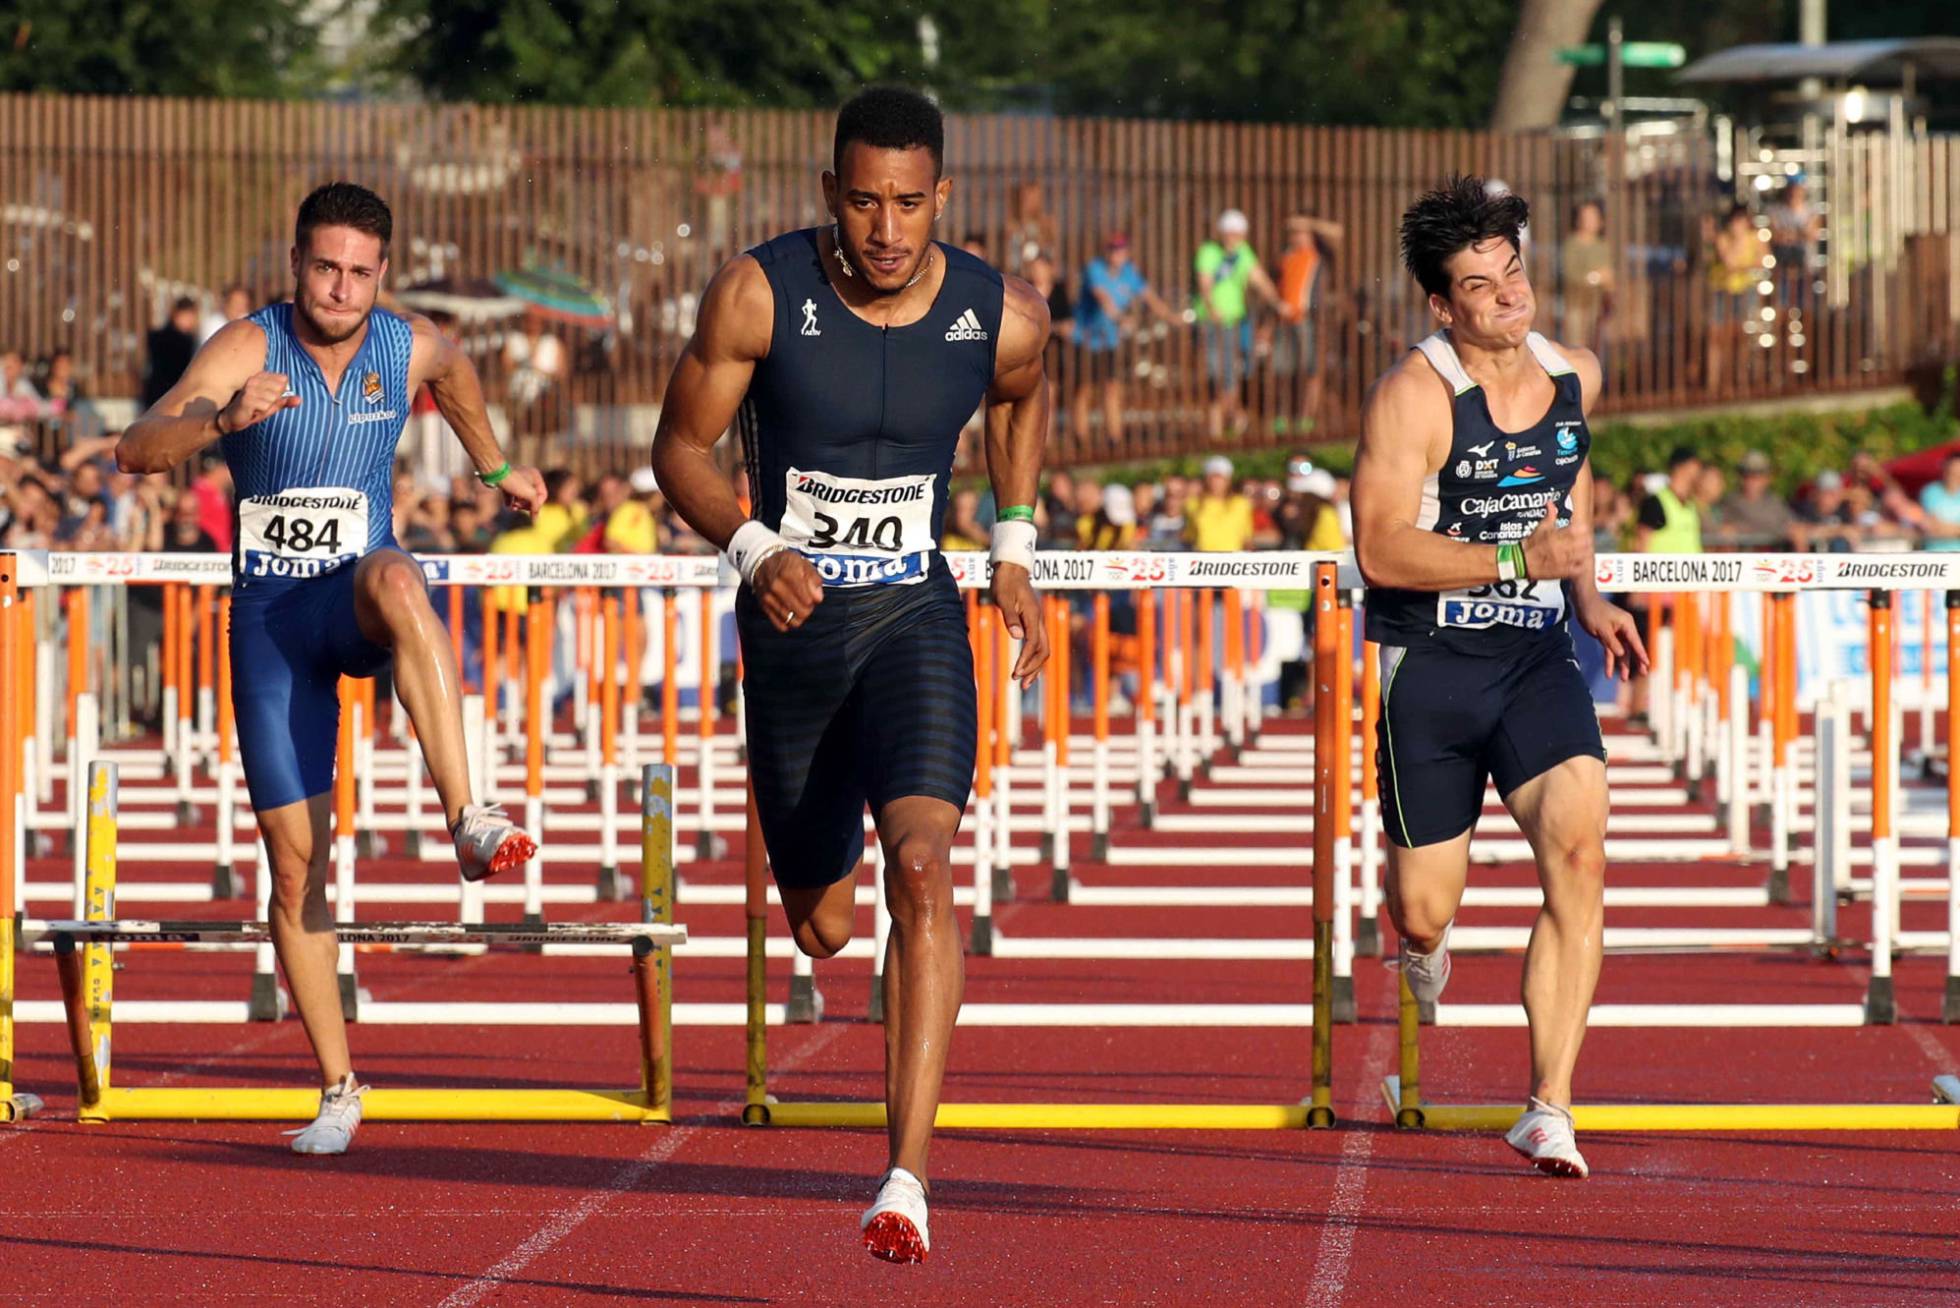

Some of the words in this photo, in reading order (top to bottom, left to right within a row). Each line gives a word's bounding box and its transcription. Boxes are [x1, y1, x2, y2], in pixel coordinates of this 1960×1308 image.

[945, 329, 988, 341] adidas
[1475, 459, 1500, 471] DXT
[796, 476, 926, 504] BRIDGESTONE
[264, 515, 342, 554] 484
[808, 512, 903, 552] 340
[1500, 522, 1522, 531] Islas
[816, 556, 907, 583] oma
[1064, 559, 1094, 580] 2017
[1131, 558, 1165, 581] 25
[1188, 560, 1301, 576] BRIDGESTONE
[1633, 561, 1708, 582] BARCELONA
[1712, 561, 1742, 582] 2017
[1780, 560, 1814, 583] 25
[1837, 561, 1949, 578] BRIDGESTONE
[1456, 603, 1544, 629] Joma
[380, 934, 410, 944] 2017
